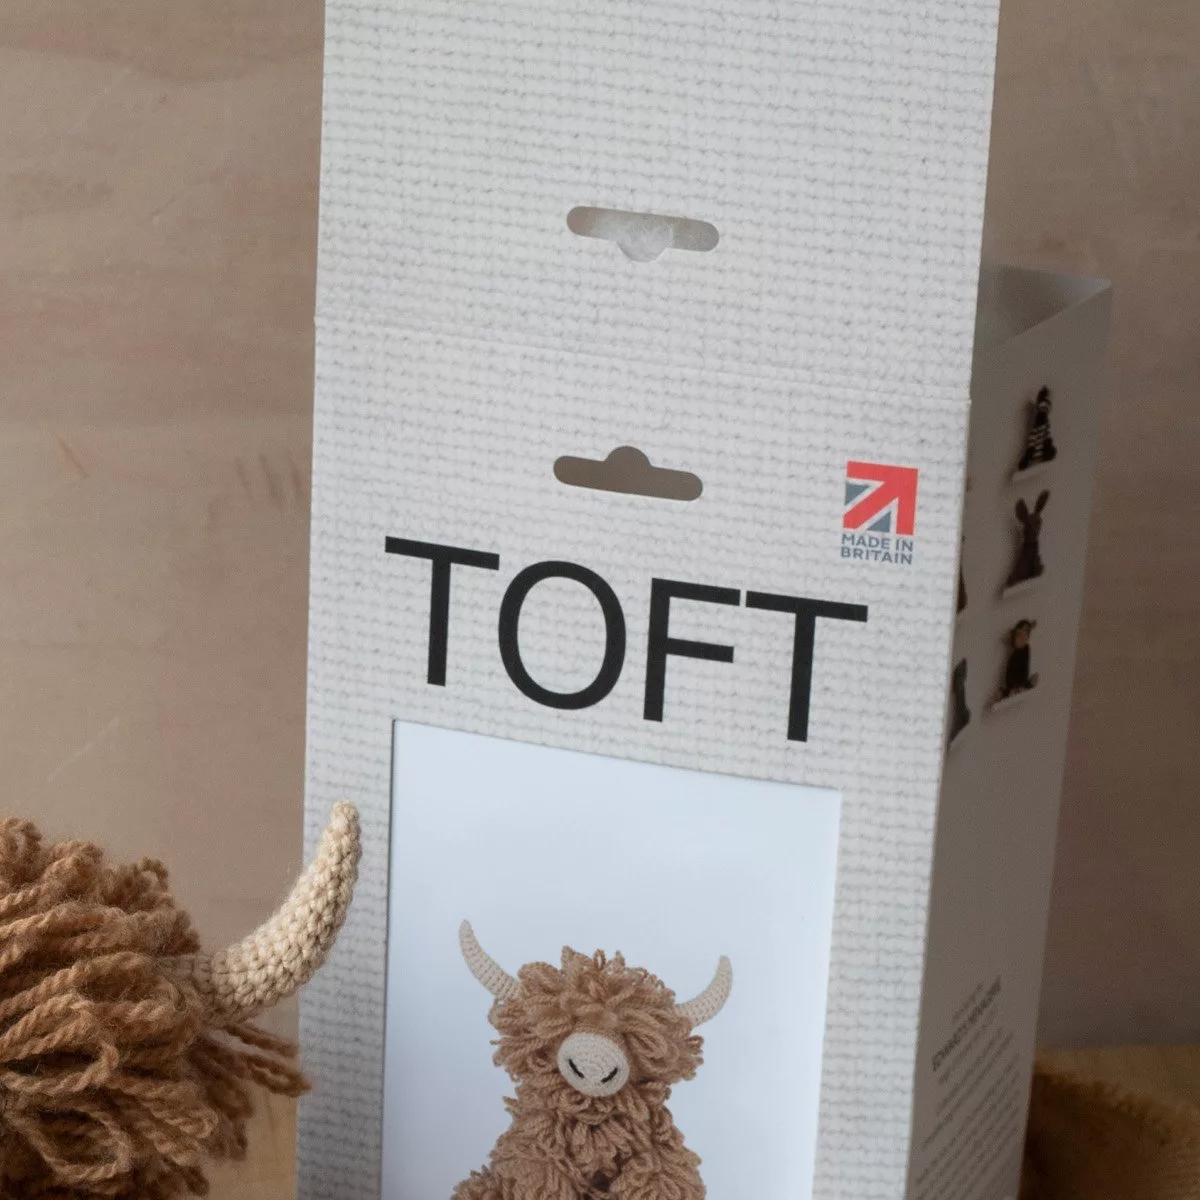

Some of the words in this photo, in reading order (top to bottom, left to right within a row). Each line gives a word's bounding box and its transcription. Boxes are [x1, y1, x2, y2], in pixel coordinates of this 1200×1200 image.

[841, 533, 890, 549] MADE
[895, 539, 914, 553] IN
[840, 546, 912, 564] BRITAIN
[384, 535, 869, 742] TOFT
